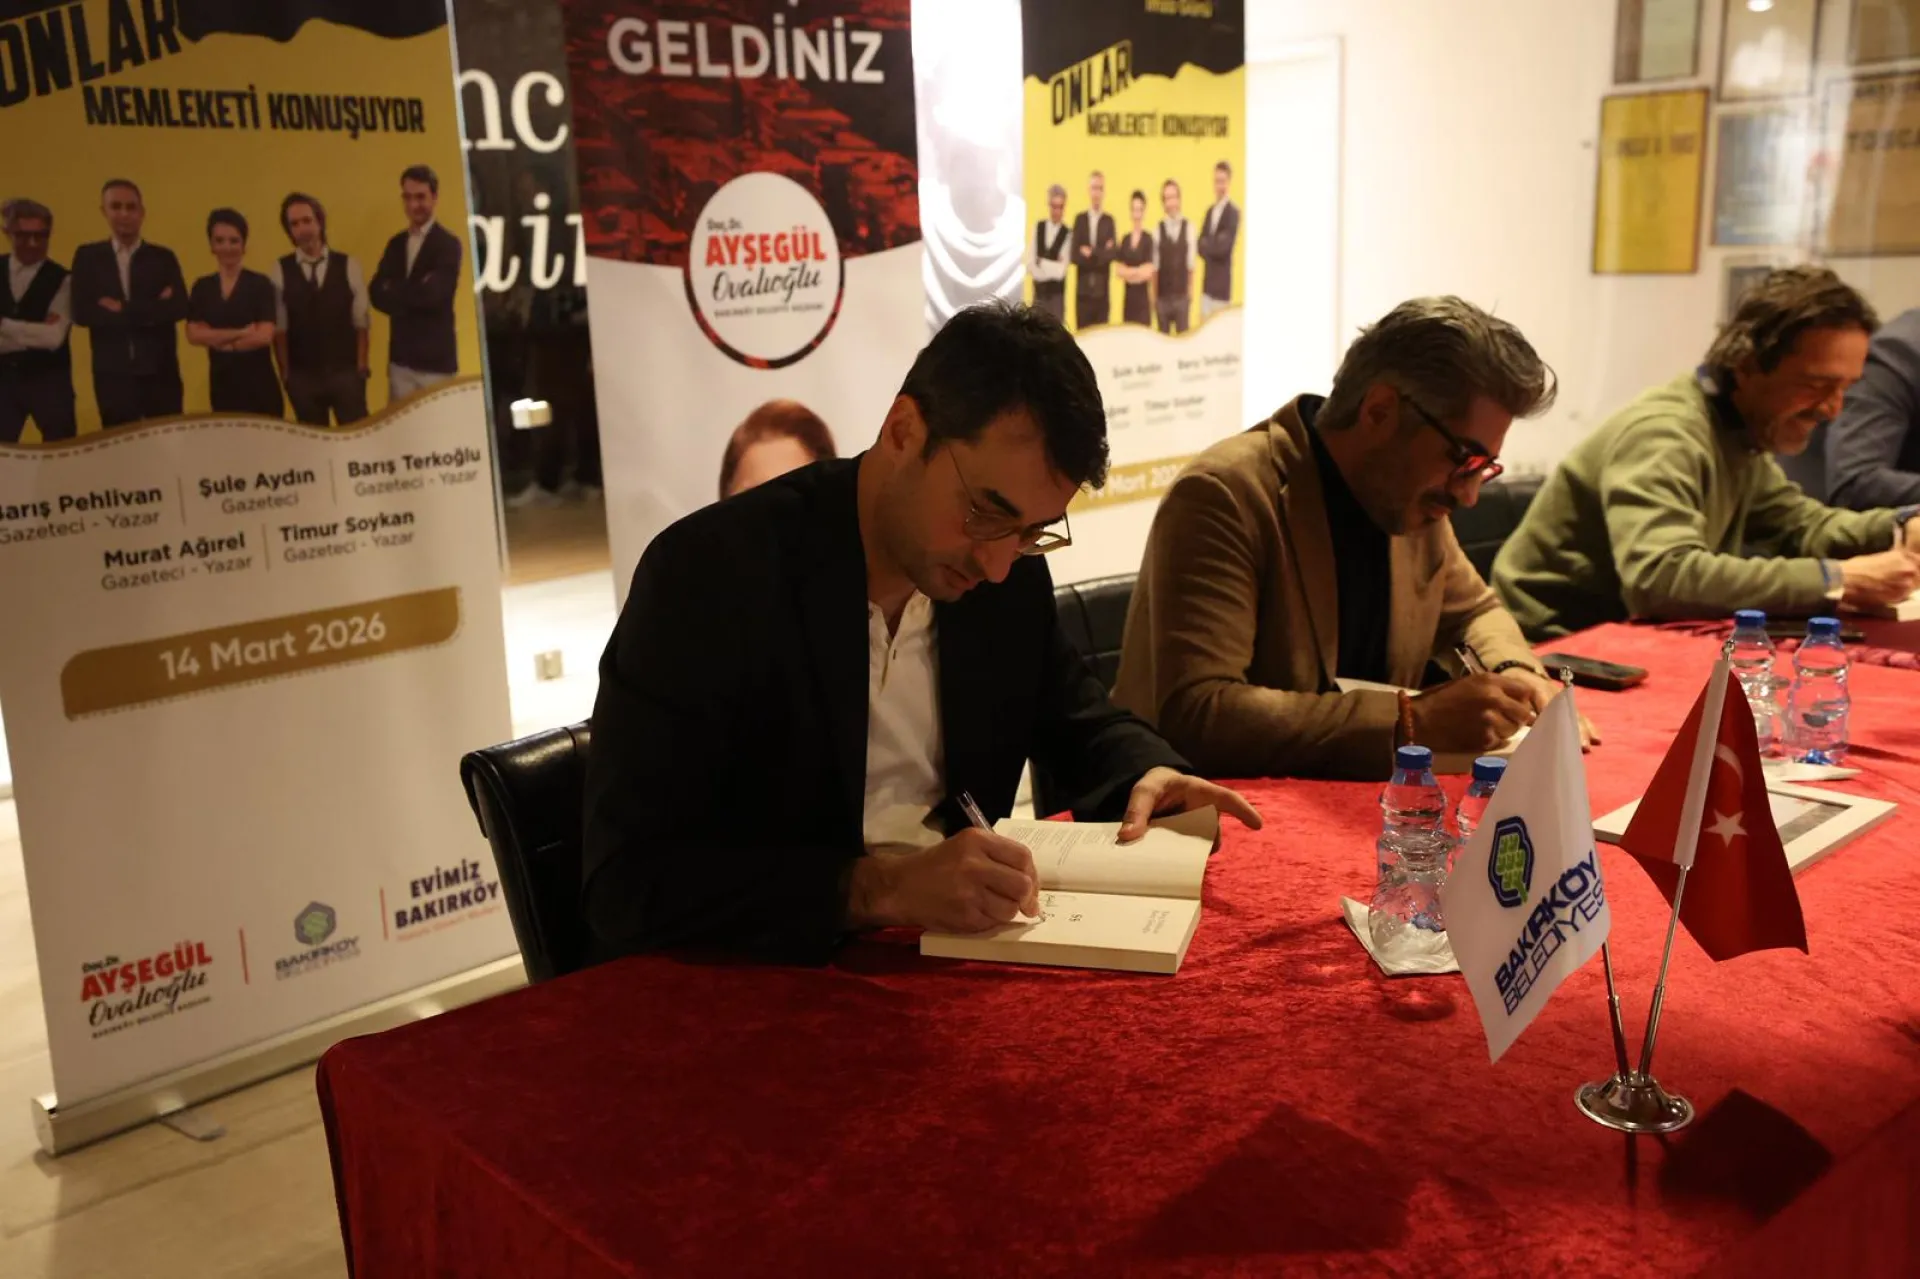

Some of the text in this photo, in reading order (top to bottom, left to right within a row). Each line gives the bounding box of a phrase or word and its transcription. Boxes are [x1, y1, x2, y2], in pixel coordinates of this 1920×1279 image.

[0, 0, 182, 107] ONLAR
[607, 13, 885, 83] GELDİNİZ
[1052, 44, 1130, 126] ONLAR
[83, 84, 426, 139] MEMLEKETİ KONUŞUYOR
[706, 225, 827, 271] AYŞEGÜL
[713, 262, 820, 303] Ovalıoğlu
[347, 446, 481, 479] Barış Terkoğlu
[59, 488, 162, 513] Pehlivan
[199, 467, 316, 498] Şule Aydın
[354, 474, 424, 498] Gazeteci
[439, 468, 478, 486] Yazar
[221, 491, 300, 515] Gazeteci
[0, 516, 86, 545] Gazeteci
[105, 511, 160, 529] Yazar
[279, 509, 415, 543] Timur Soykan
[103, 531, 246, 568] Murat Ağırel
[283, 541, 357, 564] Gazeteci
[371, 530, 415, 549] Yazar
[101, 565, 186, 591] Gazeteci
[203, 556, 253, 575] Yazar
[159, 612, 387, 681] 14 Mart 2026
[410, 858, 481, 899] EVİMİZ
[395, 880, 499, 930] BAKIRKÖY
[81, 939, 214, 1003] AYŞEGÜL
